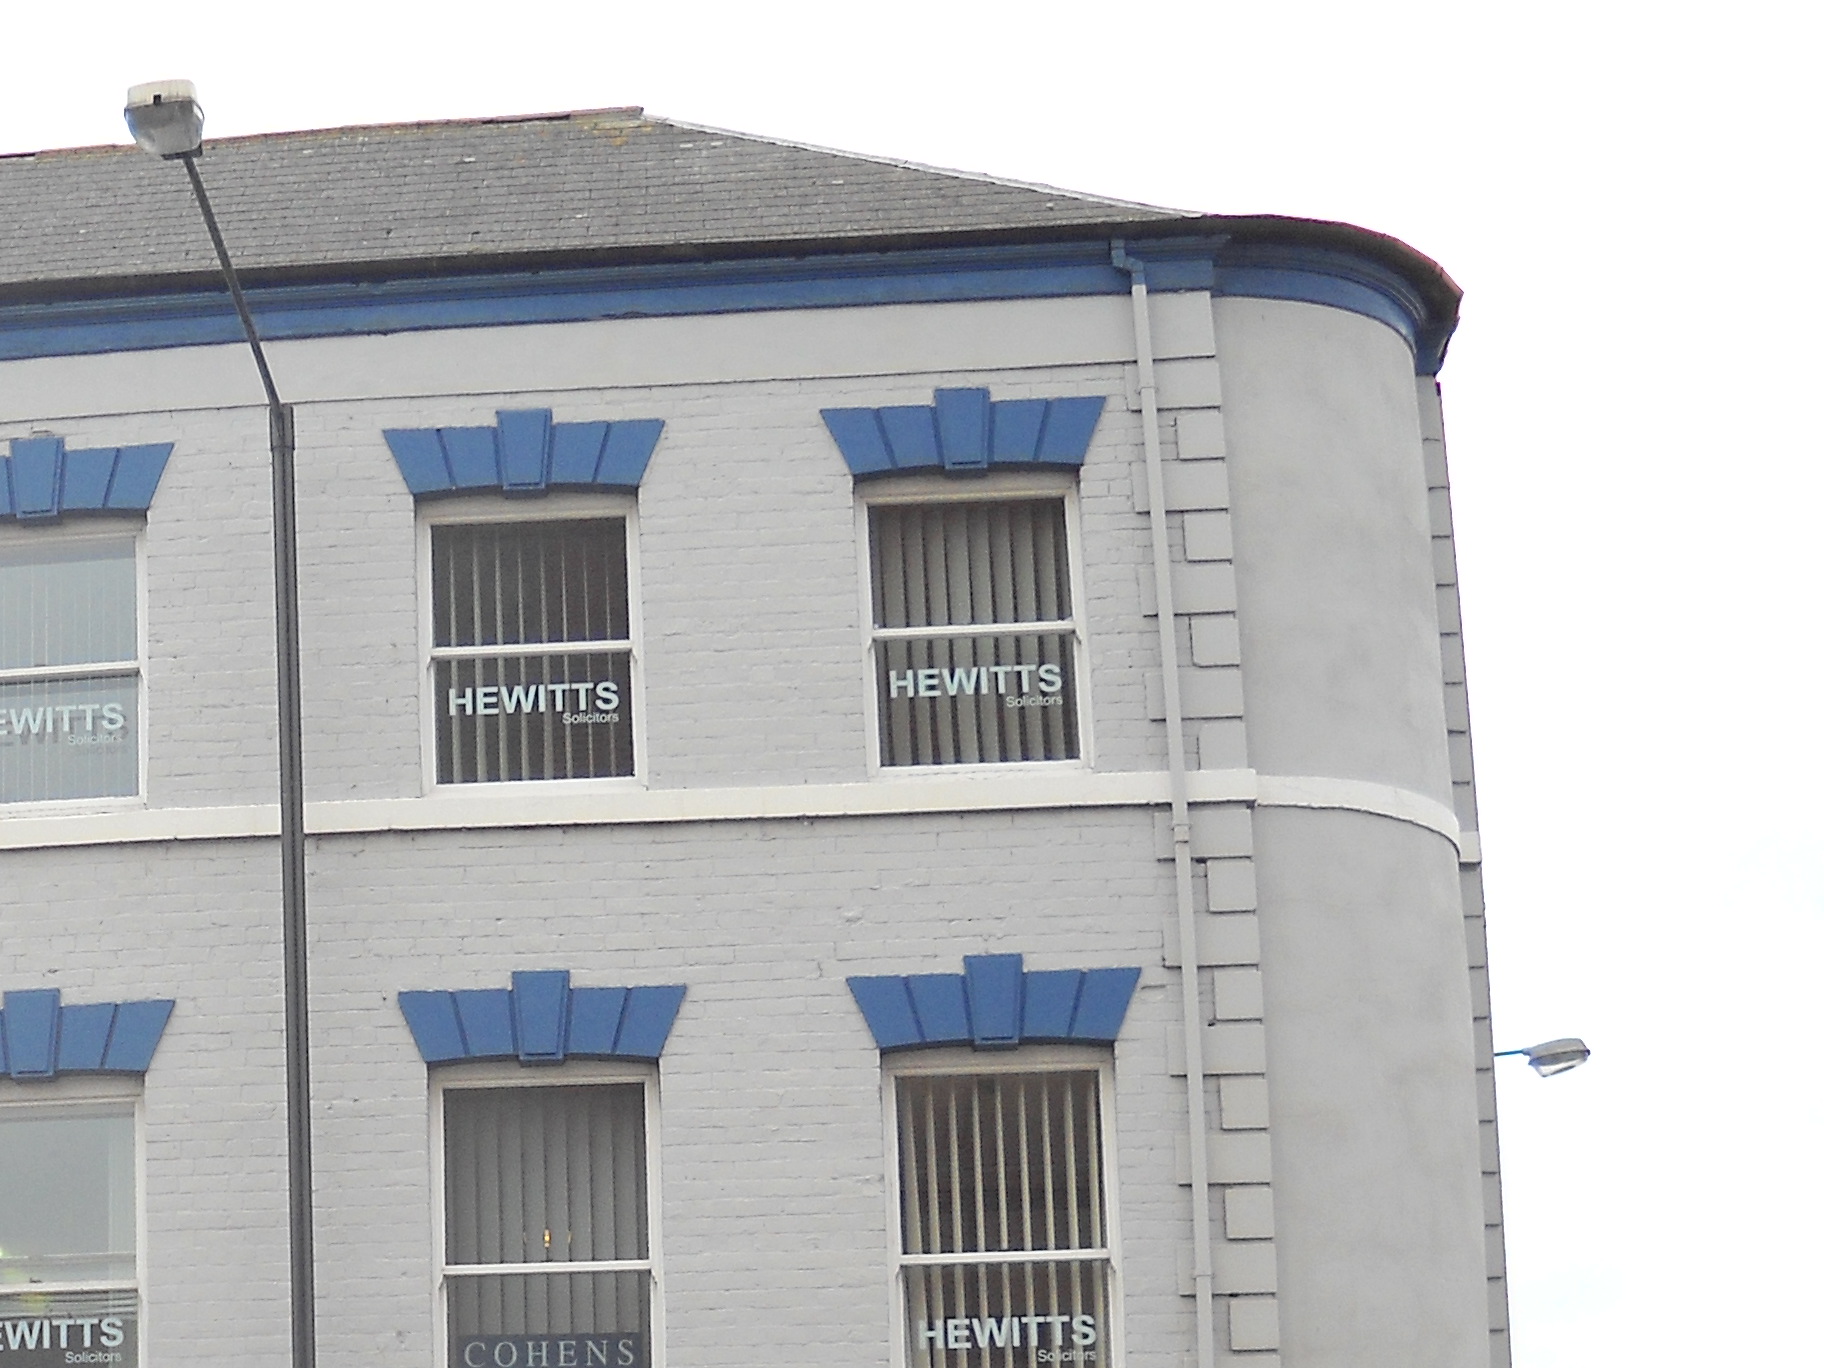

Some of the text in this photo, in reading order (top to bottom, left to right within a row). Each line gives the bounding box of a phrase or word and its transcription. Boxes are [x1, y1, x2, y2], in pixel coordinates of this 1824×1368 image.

[889, 663, 1063, 698] HEWITTS
[448, 681, 619, 716] HEWITTS
[1005, 694, 1064, 708] Solicitors
[562, 711, 620, 724] Solicitors
[917, 1314, 1097, 1350] HEWITTS
[64, 1350, 122, 1364] Solicitors
[463, 1339, 635, 1368] COHENS
